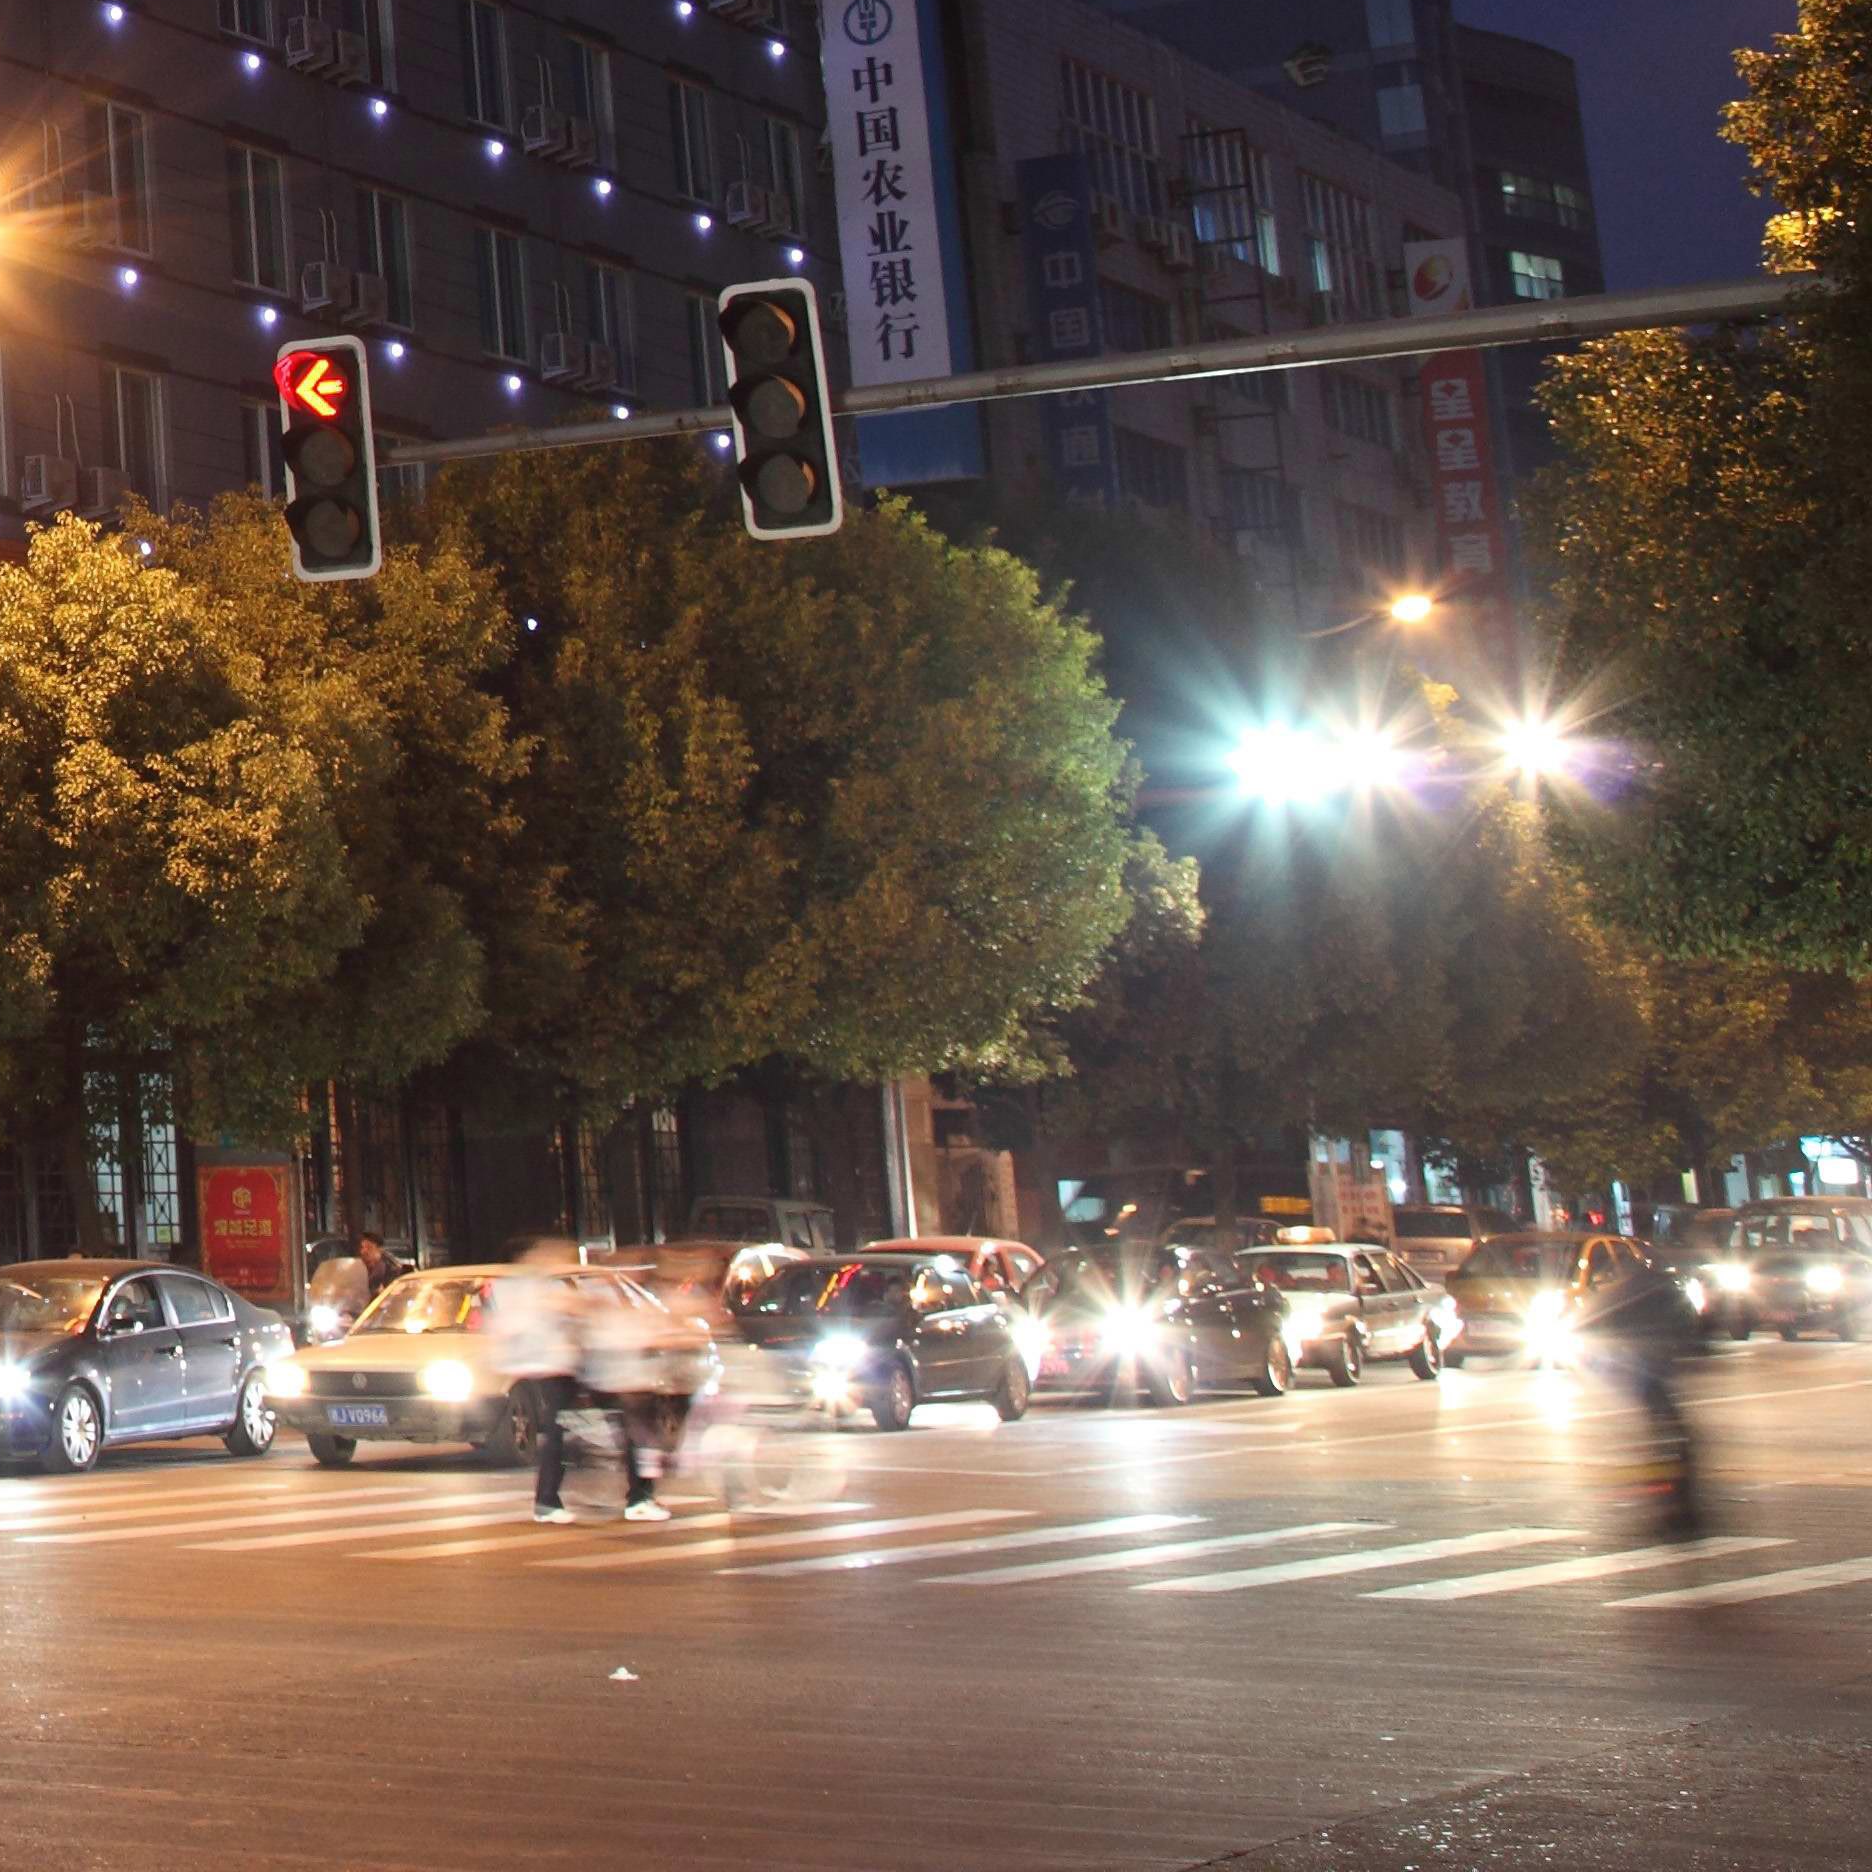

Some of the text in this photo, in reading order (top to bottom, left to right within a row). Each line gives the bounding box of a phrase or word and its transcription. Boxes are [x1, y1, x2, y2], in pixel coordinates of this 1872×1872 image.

[851, 55, 921, 363] 中国农业银行
